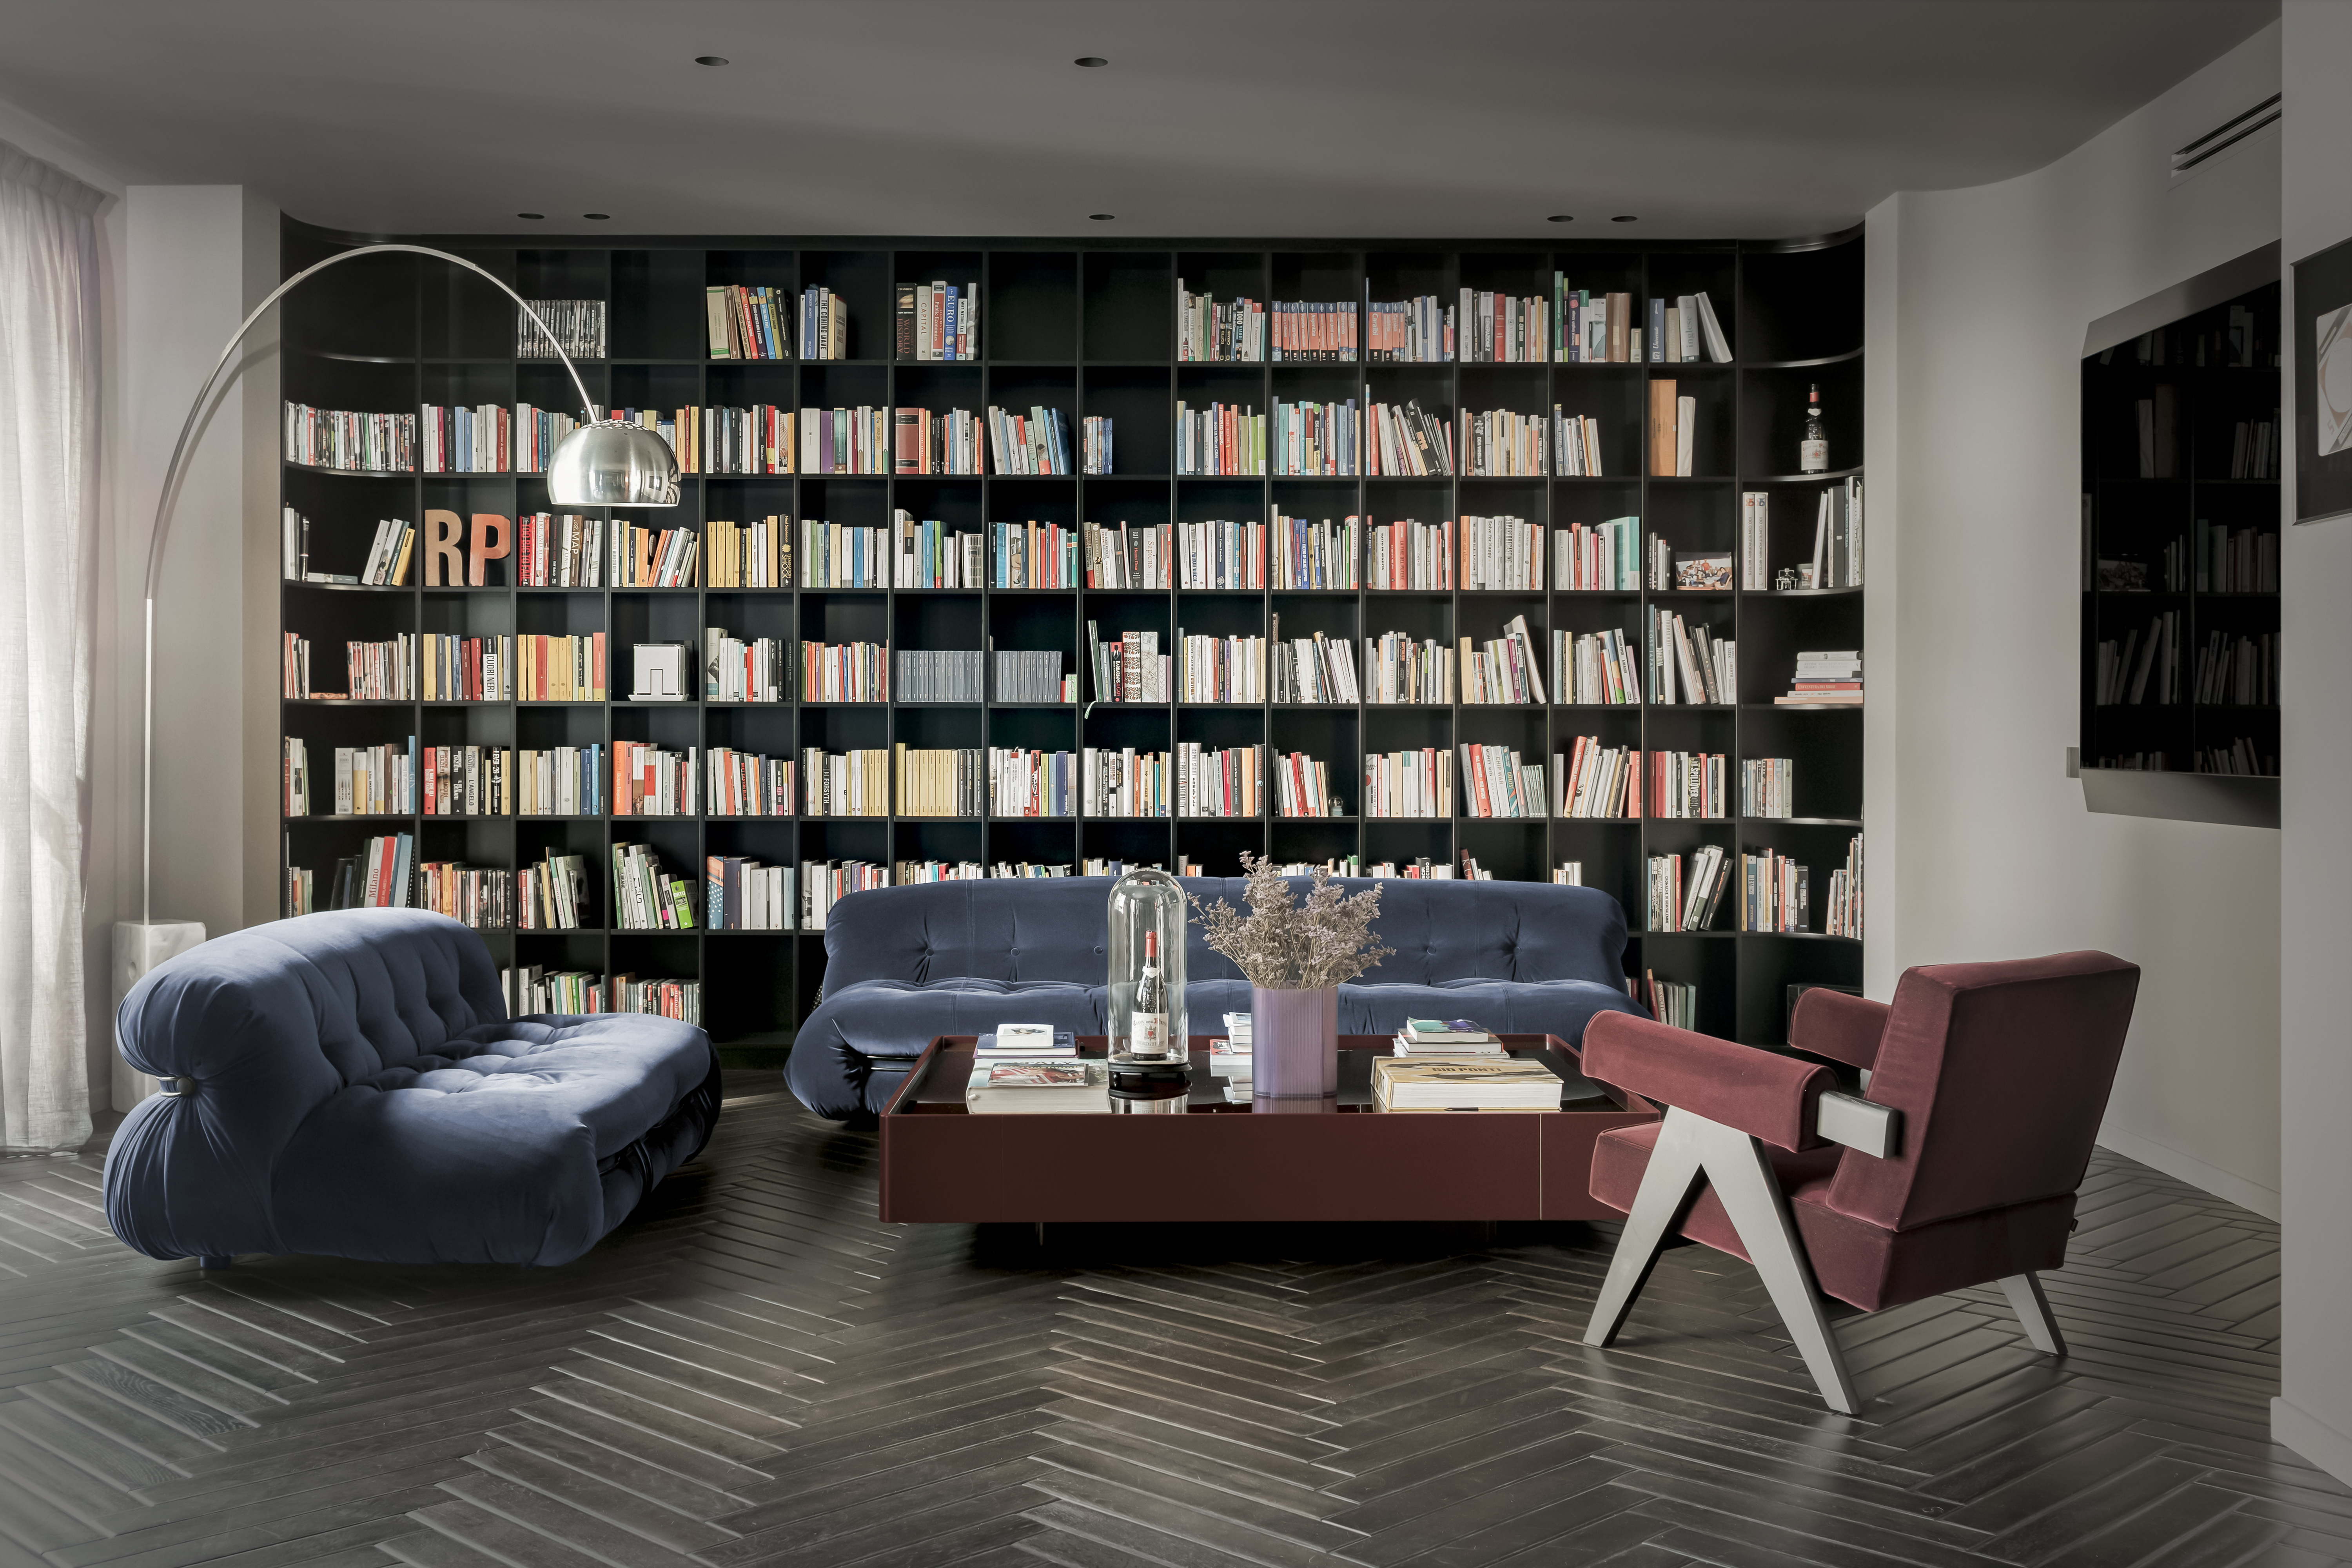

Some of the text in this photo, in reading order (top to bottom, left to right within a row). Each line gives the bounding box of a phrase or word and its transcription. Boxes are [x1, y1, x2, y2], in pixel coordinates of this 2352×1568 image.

[425, 510, 510, 586] RP
[1146, 541, 1154, 568] Sapiens
[368, 869, 378, 897] Milano
